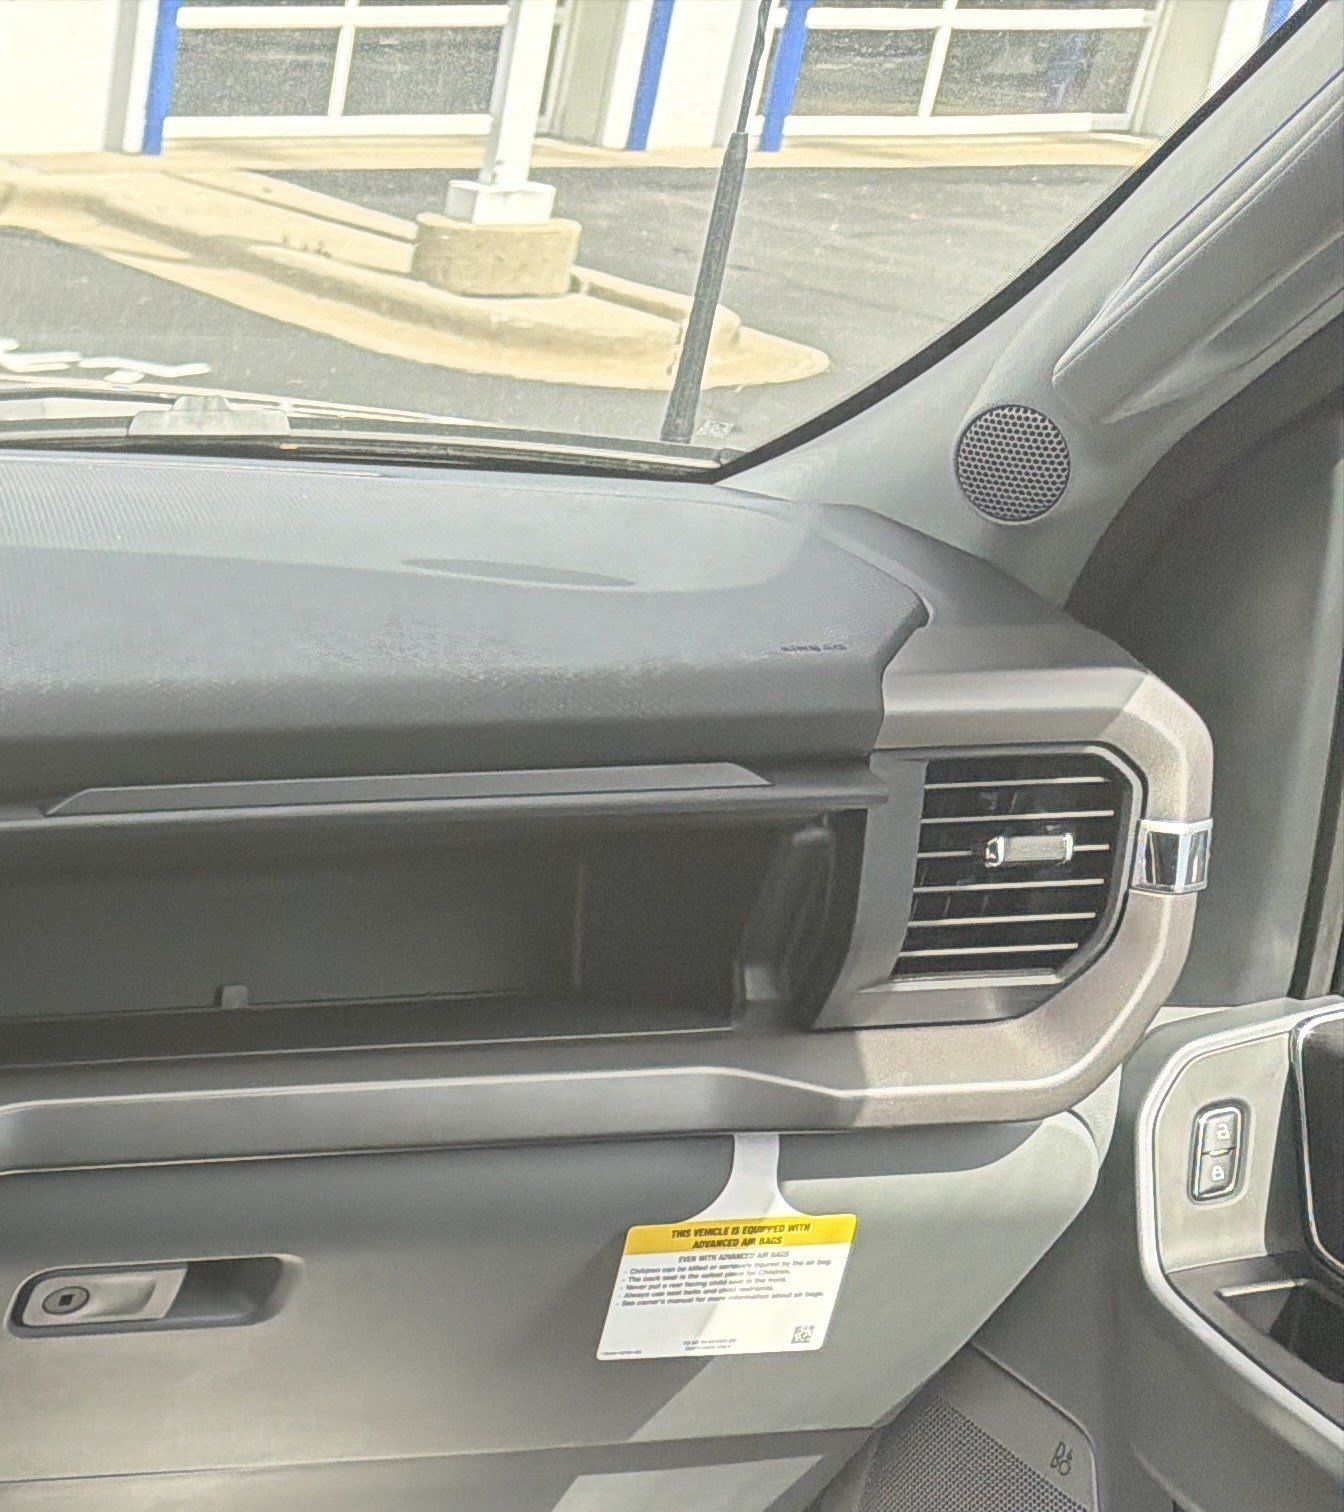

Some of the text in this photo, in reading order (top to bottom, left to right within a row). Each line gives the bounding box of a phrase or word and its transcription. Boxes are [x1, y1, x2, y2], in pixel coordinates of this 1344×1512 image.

[672, 1222, 811, 1239] THIS VEHICLE IS EQUIPPED WITH
[692, 1236, 783, 1249] ADVANCED AIR BAGS
